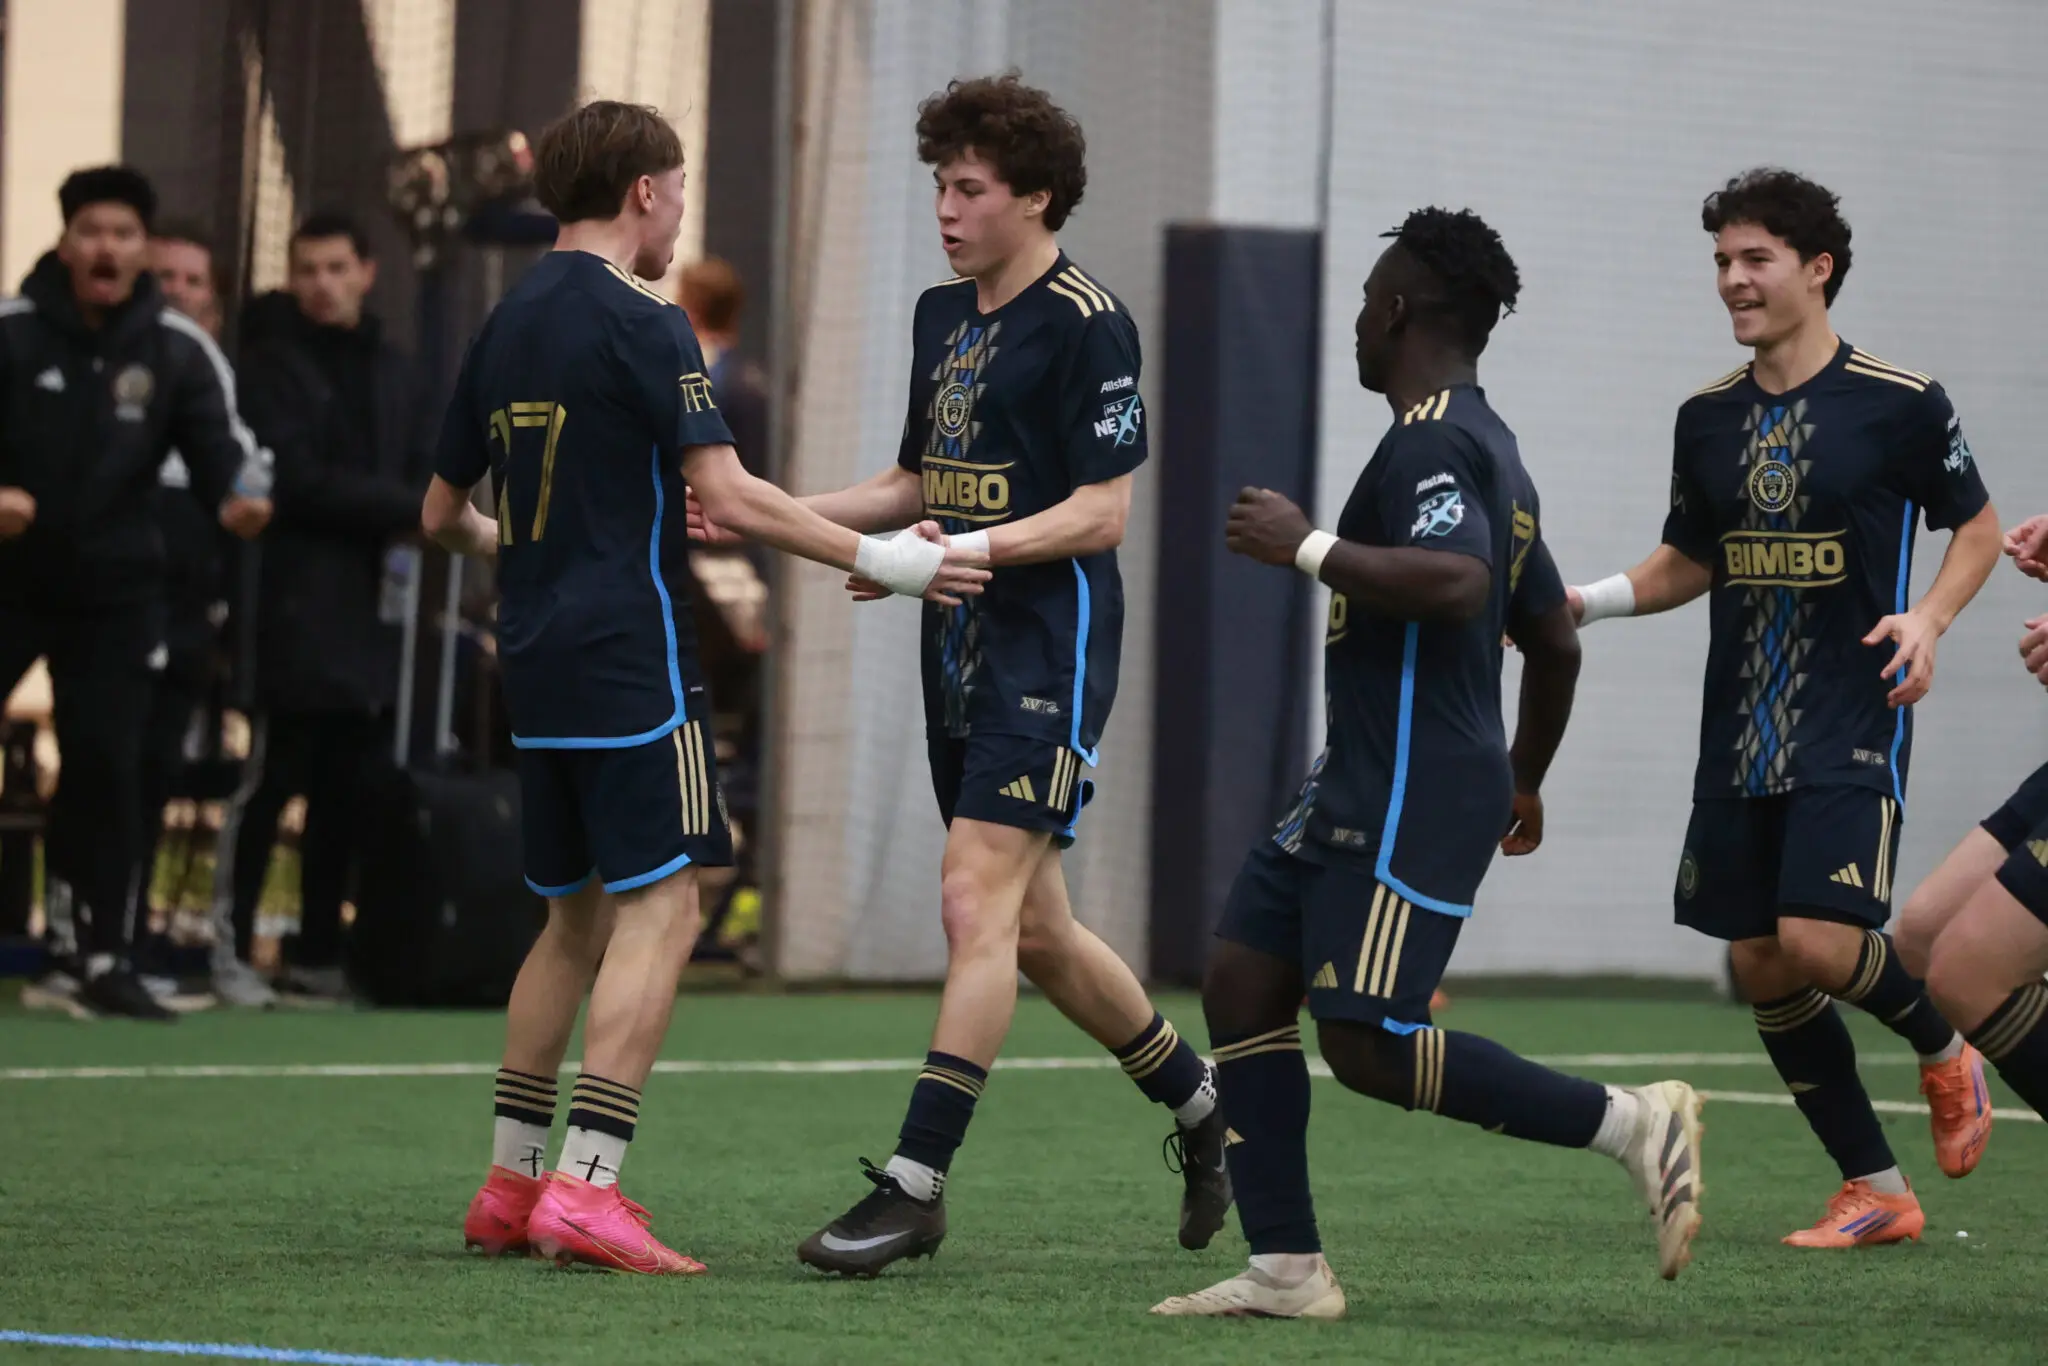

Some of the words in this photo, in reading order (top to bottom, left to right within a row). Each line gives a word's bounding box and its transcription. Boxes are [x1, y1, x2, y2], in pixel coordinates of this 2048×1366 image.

[1100, 376, 1134, 394] Allstate
[1106, 403, 1124, 414] MLS
[922, 468, 1009, 510] IMBO
[1724, 541, 1845, 576] BIMBO
